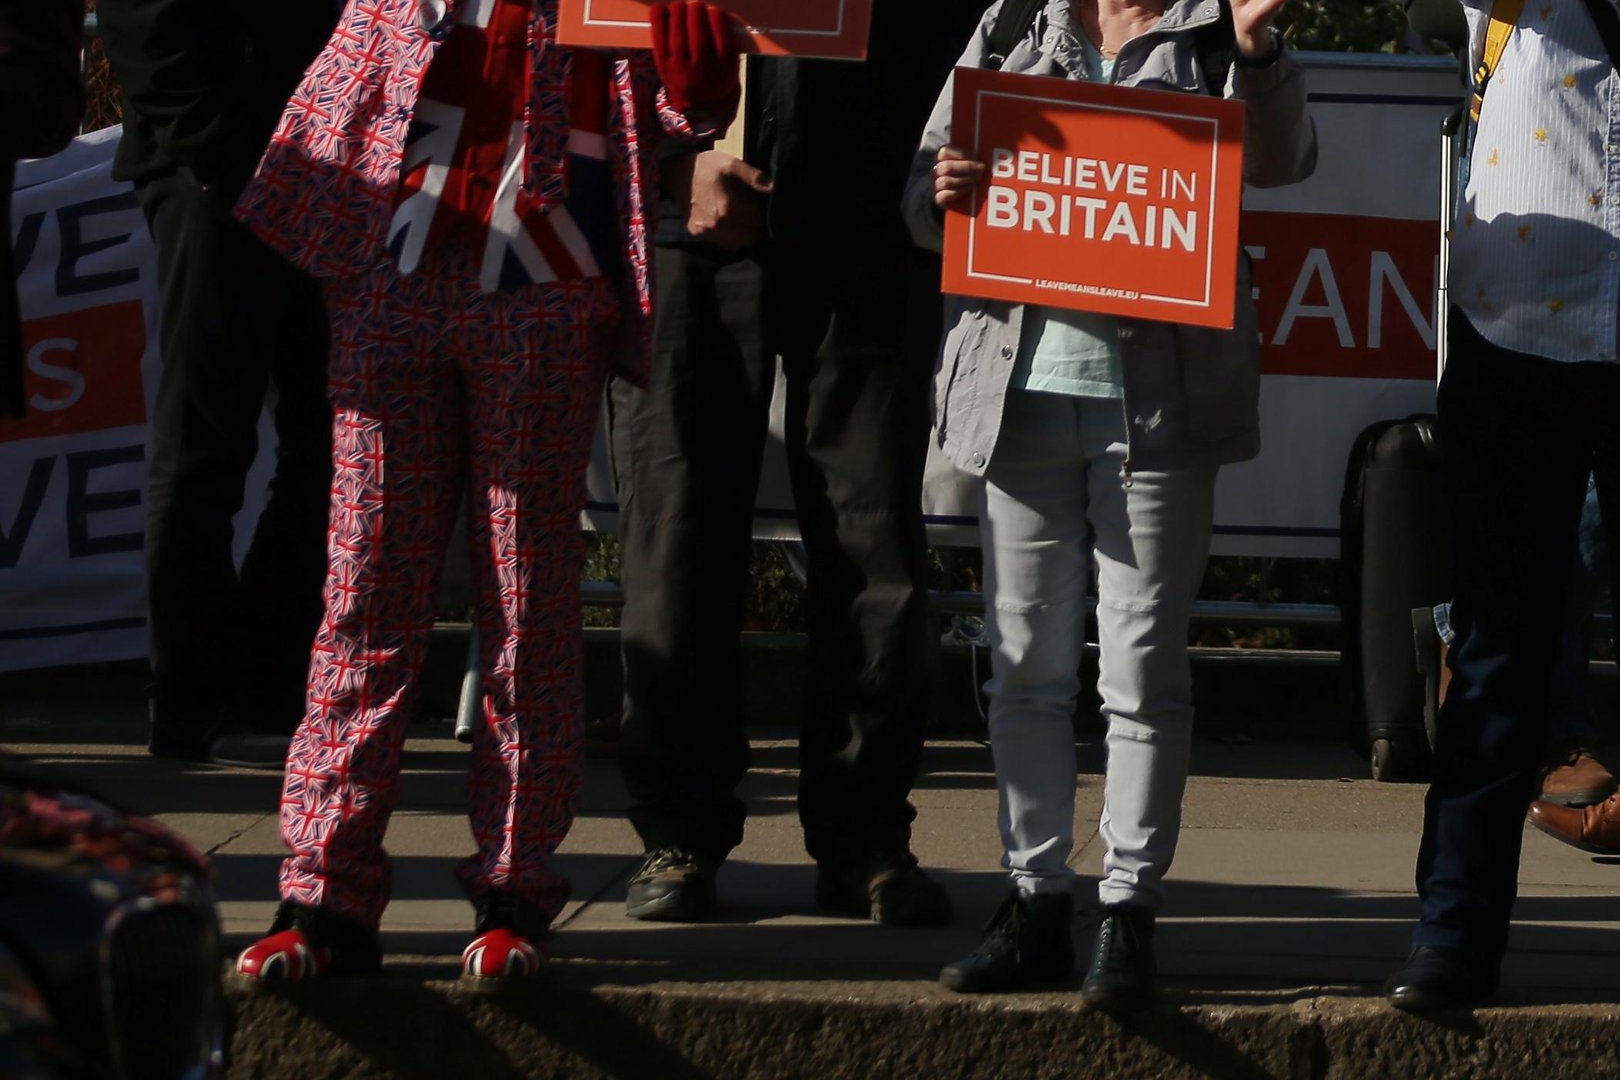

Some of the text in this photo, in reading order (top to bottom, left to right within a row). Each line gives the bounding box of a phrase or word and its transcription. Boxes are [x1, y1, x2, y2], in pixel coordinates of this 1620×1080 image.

[991, 147, 1197, 202] BELIEVE IN
[986, 185, 1197, 252] BRITAIN
[1035, 278, 1139, 300] LEAVEMEANSLEAVE.EU
